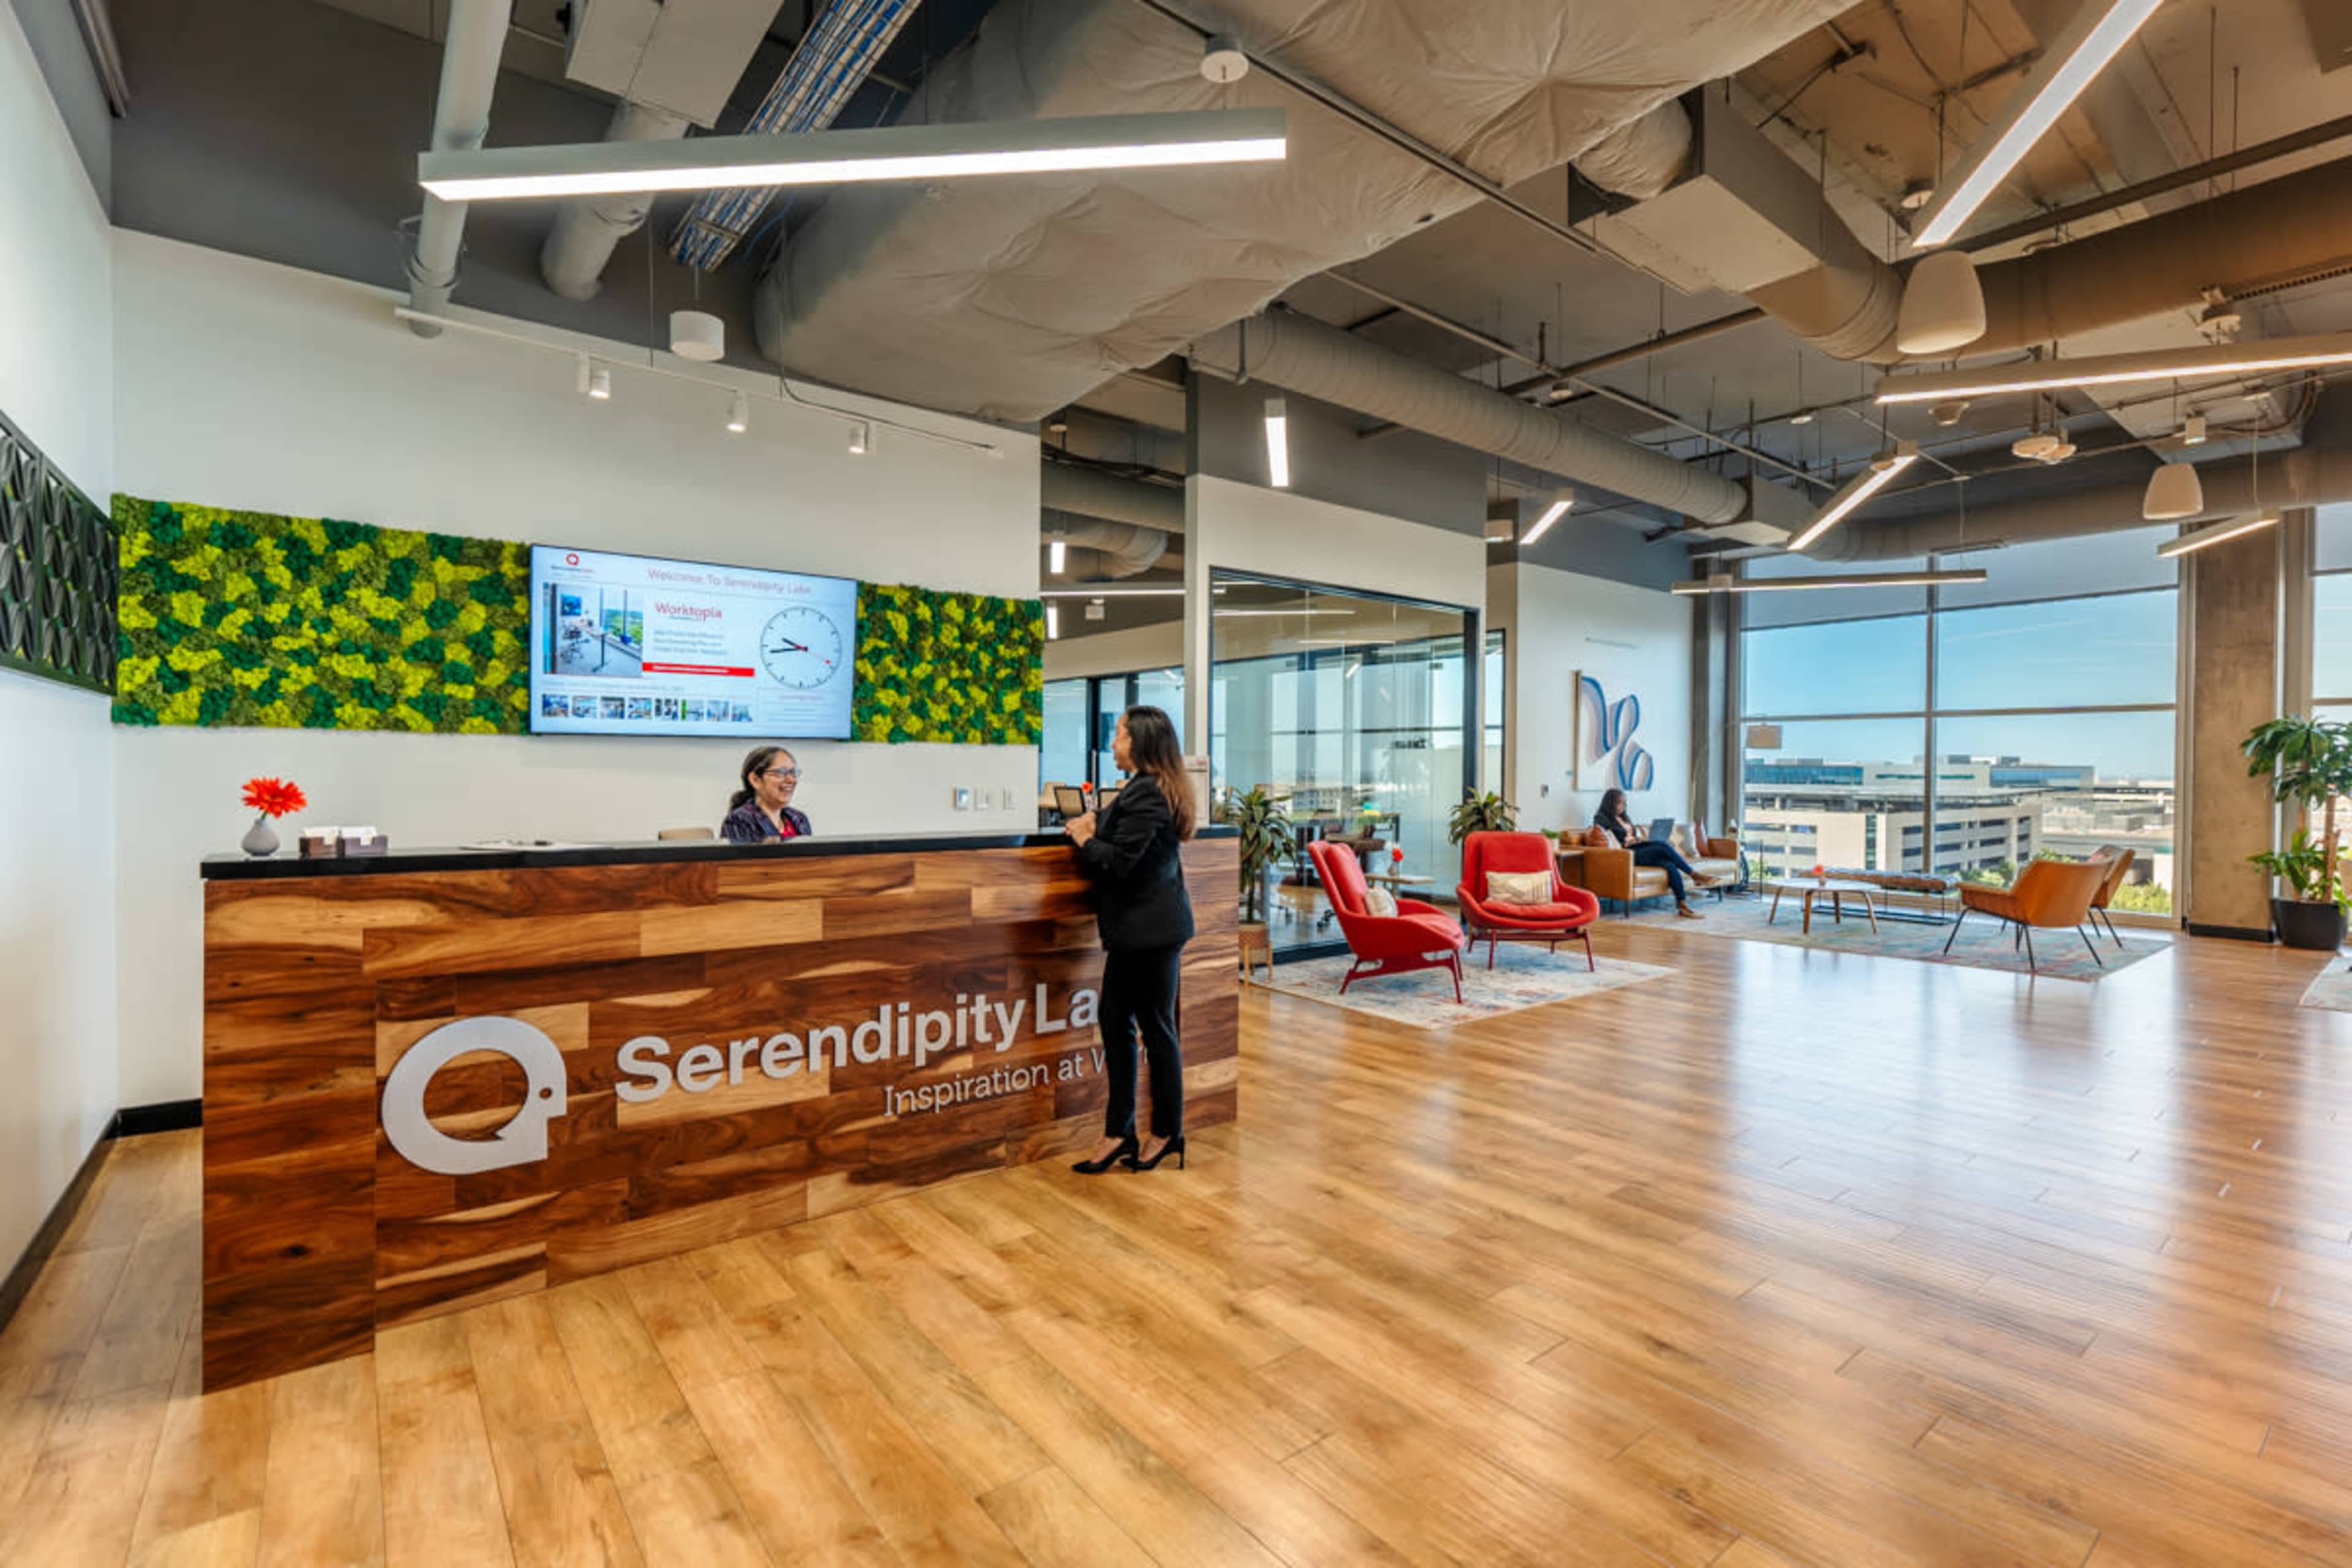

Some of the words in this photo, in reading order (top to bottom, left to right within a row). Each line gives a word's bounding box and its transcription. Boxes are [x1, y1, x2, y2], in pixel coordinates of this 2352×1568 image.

[648, 568, 703, 583] Welcome
[705, 574, 721, 586] To
[655, 603, 722, 622] Worktopia
[614, 993, 1027, 1102] Serendipity
[1036, 983, 1099, 1035] La
[884, 1063, 1049, 1117] Inspiration
[1058, 1053, 1084, 1081] at
